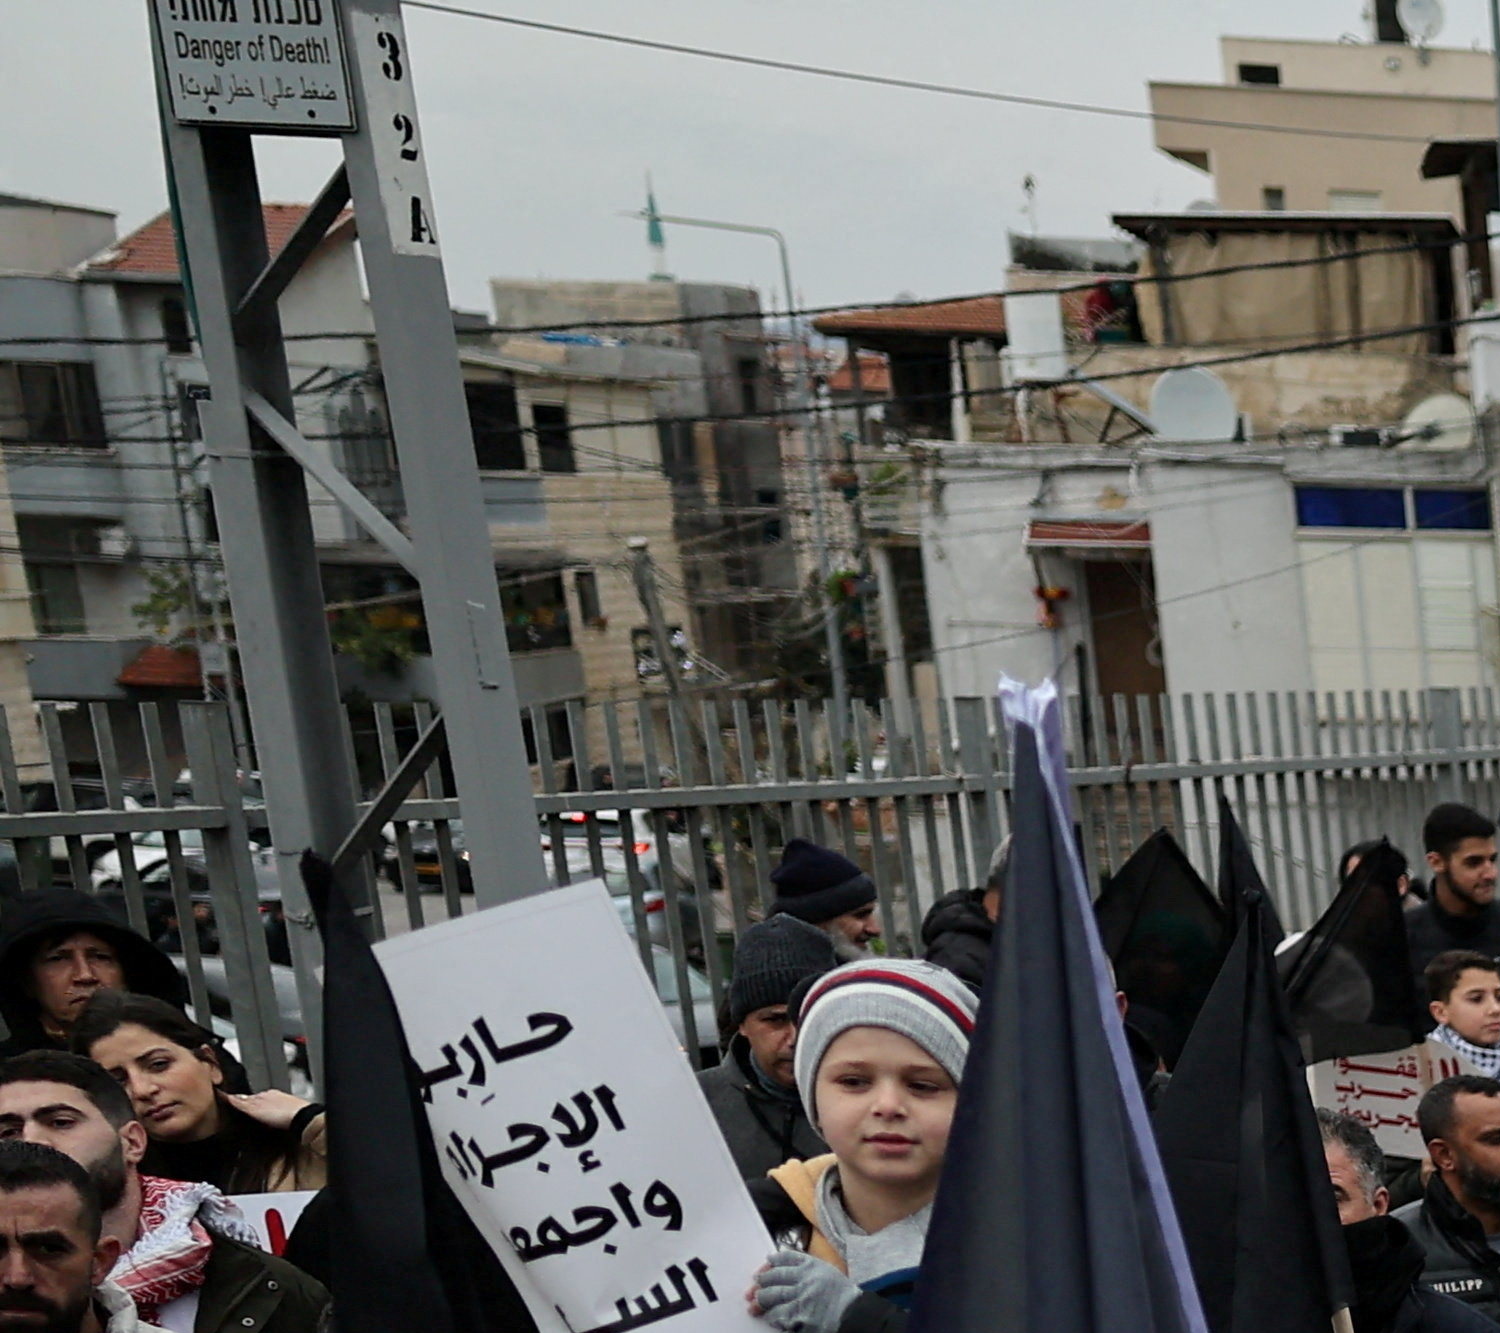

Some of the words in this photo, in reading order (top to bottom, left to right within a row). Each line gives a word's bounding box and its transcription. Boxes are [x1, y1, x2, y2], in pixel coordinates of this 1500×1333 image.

[173, 31, 242, 67] Danger
[247, 35, 264, 61] of
[271, 34, 332, 64] Death!
